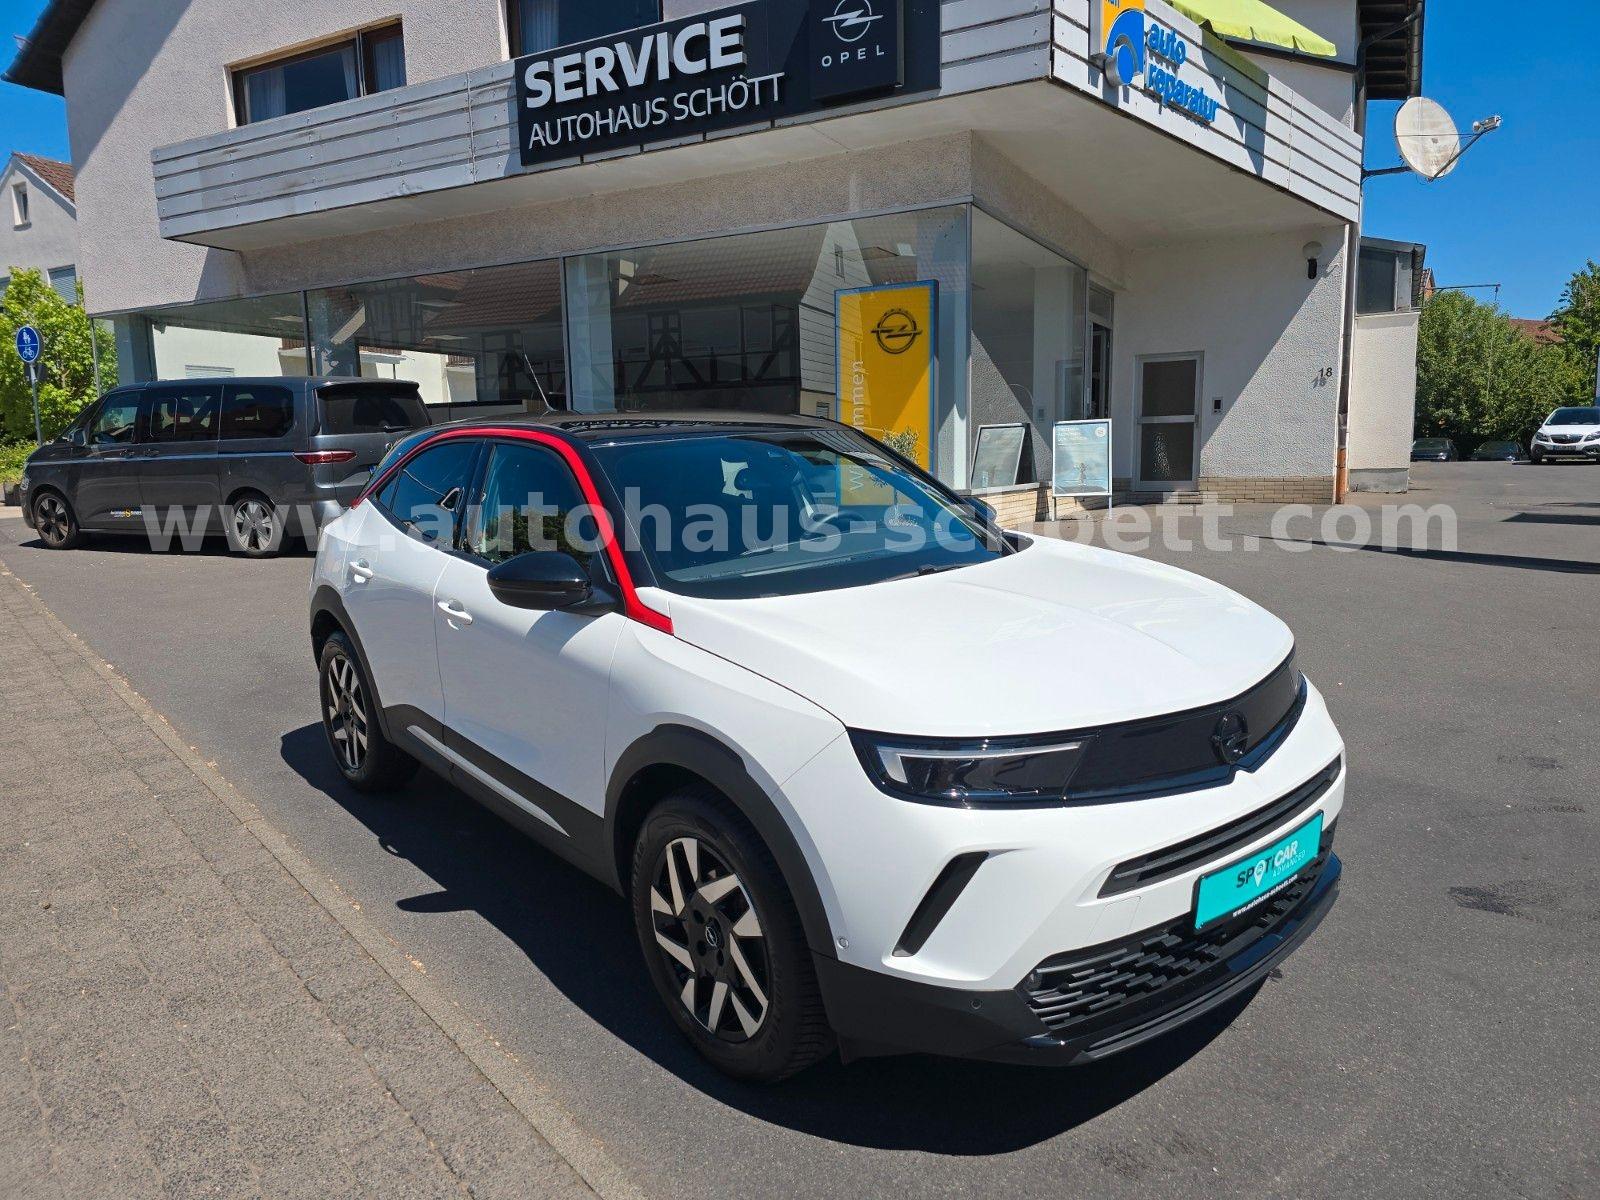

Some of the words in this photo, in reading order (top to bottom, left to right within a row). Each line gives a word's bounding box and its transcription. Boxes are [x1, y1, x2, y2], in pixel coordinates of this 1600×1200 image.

[524, 13, 746, 109] SERVICE
[821, 44, 885, 68] OPEL
[1148, 23, 1187, 65] auto
[528, 97, 668, 150] AUTOHAUS
[673, 72, 785, 121] SCHÖTT
[1149, 63, 1219, 122] reparatur
[1318, 367, 1333, 378] 18
[1273, 849, 1306, 878] ADVANCED
